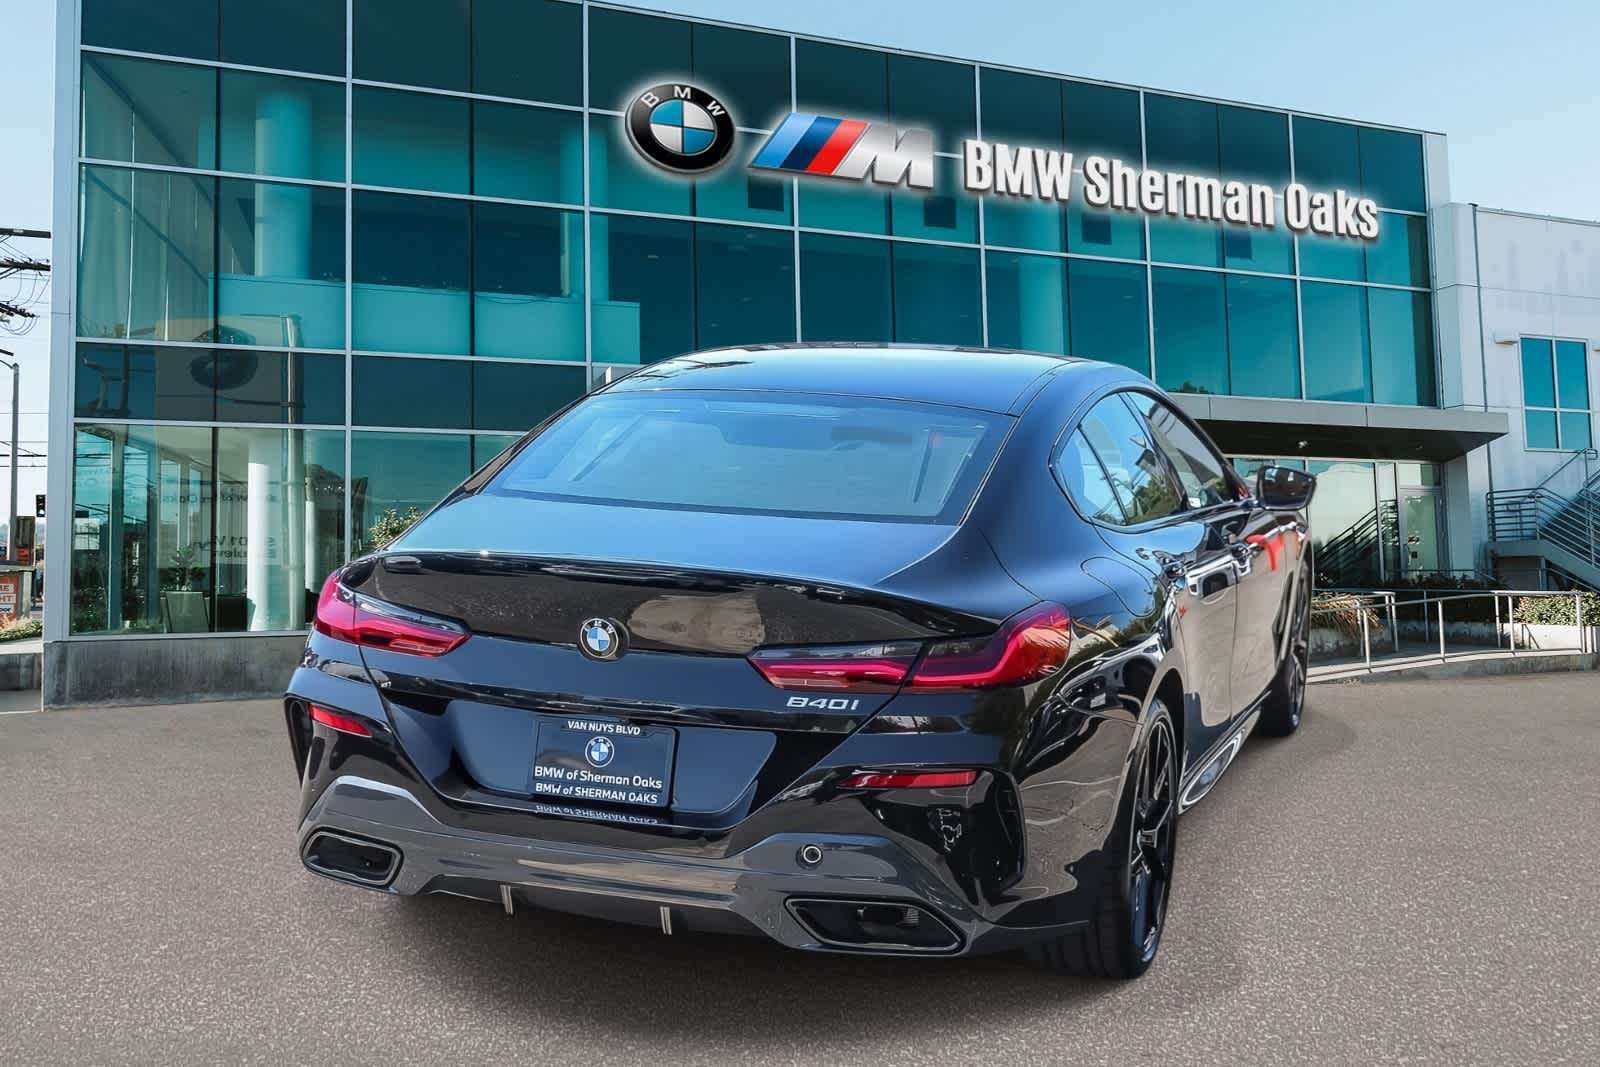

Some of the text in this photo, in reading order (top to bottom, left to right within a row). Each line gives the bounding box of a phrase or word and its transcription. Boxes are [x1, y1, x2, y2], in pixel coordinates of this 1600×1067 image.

[641, 84, 727, 118] BMW
[963, 138, 1379, 241] BMW Sherman Oaks
[567, 720, 641, 736] VAN NUYS BLVD
[534, 766, 663, 789] BMW of Sherman Oaks
[535, 782, 658, 804] BMW of SHERMAN OAKS
